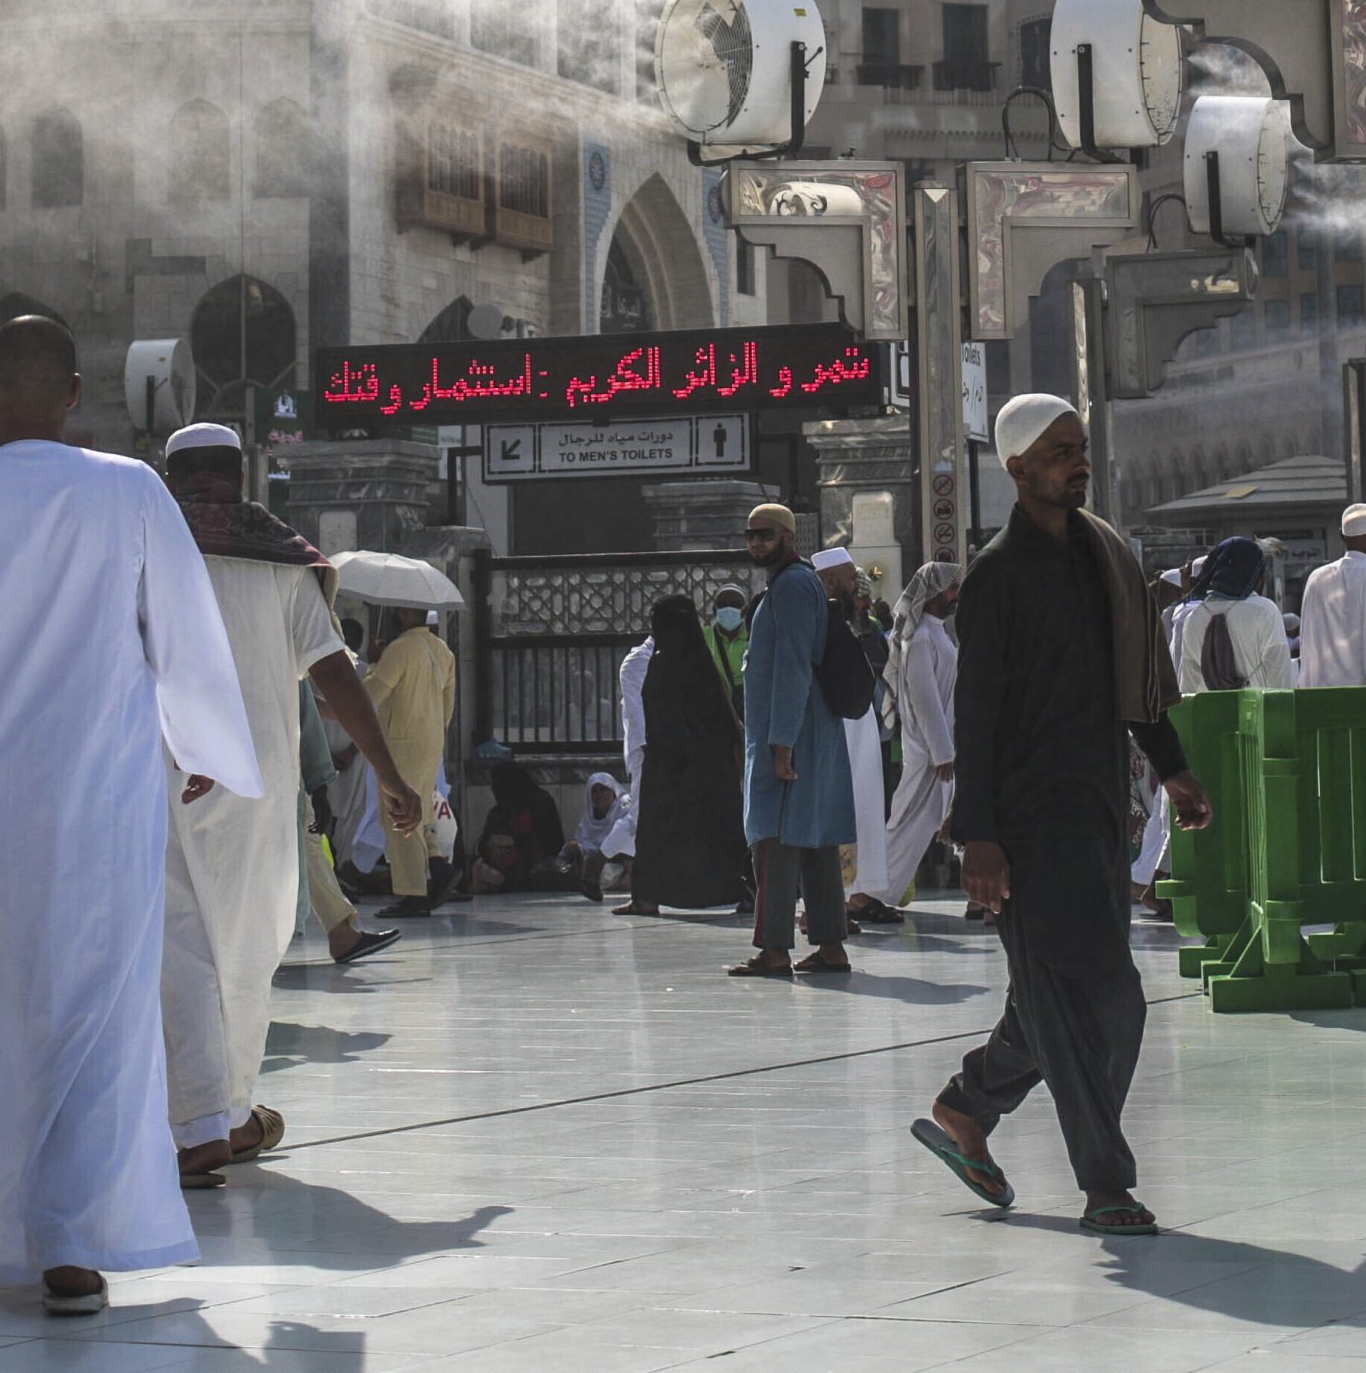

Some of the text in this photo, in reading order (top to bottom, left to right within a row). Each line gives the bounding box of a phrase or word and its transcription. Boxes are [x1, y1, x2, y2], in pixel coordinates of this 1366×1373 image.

[324, 360, 402, 415] وقتك
[409, 352, 532, 411] استثمار
[566, 345, 662, 408] الكريم
[671, 341, 758, 399] الزائر
[558, 430, 674, 448] دورات مياه للرجال
[558, 447, 673, 463] TO MEN'S TOILETS
